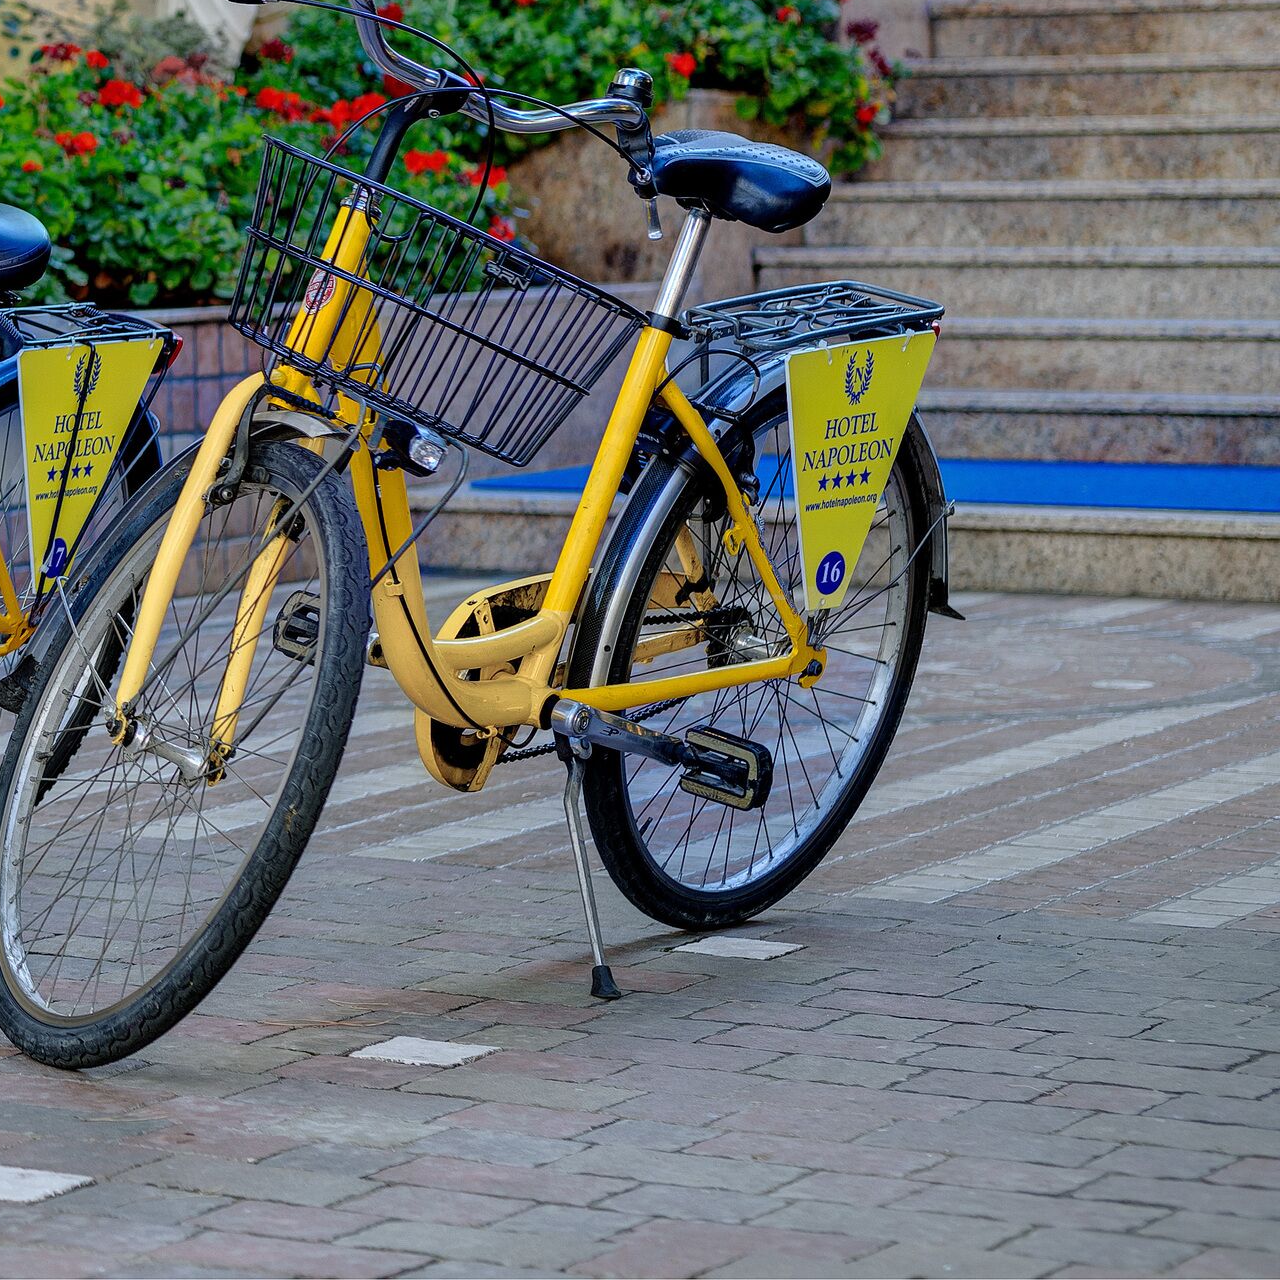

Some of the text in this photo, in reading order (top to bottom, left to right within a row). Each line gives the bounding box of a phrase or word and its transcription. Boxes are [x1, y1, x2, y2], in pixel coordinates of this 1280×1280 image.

[486, 263, 531, 291] BRN
[853, 366, 865, 383] N
[53, 410, 103, 434] HOTEL
[824, 412, 880, 440] HOTEL
[802, 437, 894, 473] NAPOLEON
[34, 485, 99, 501] www.hotnapoleon.org
[805, 492, 878, 513] www.hotelnapoleon.org
[820, 560, 842, 584] 16
